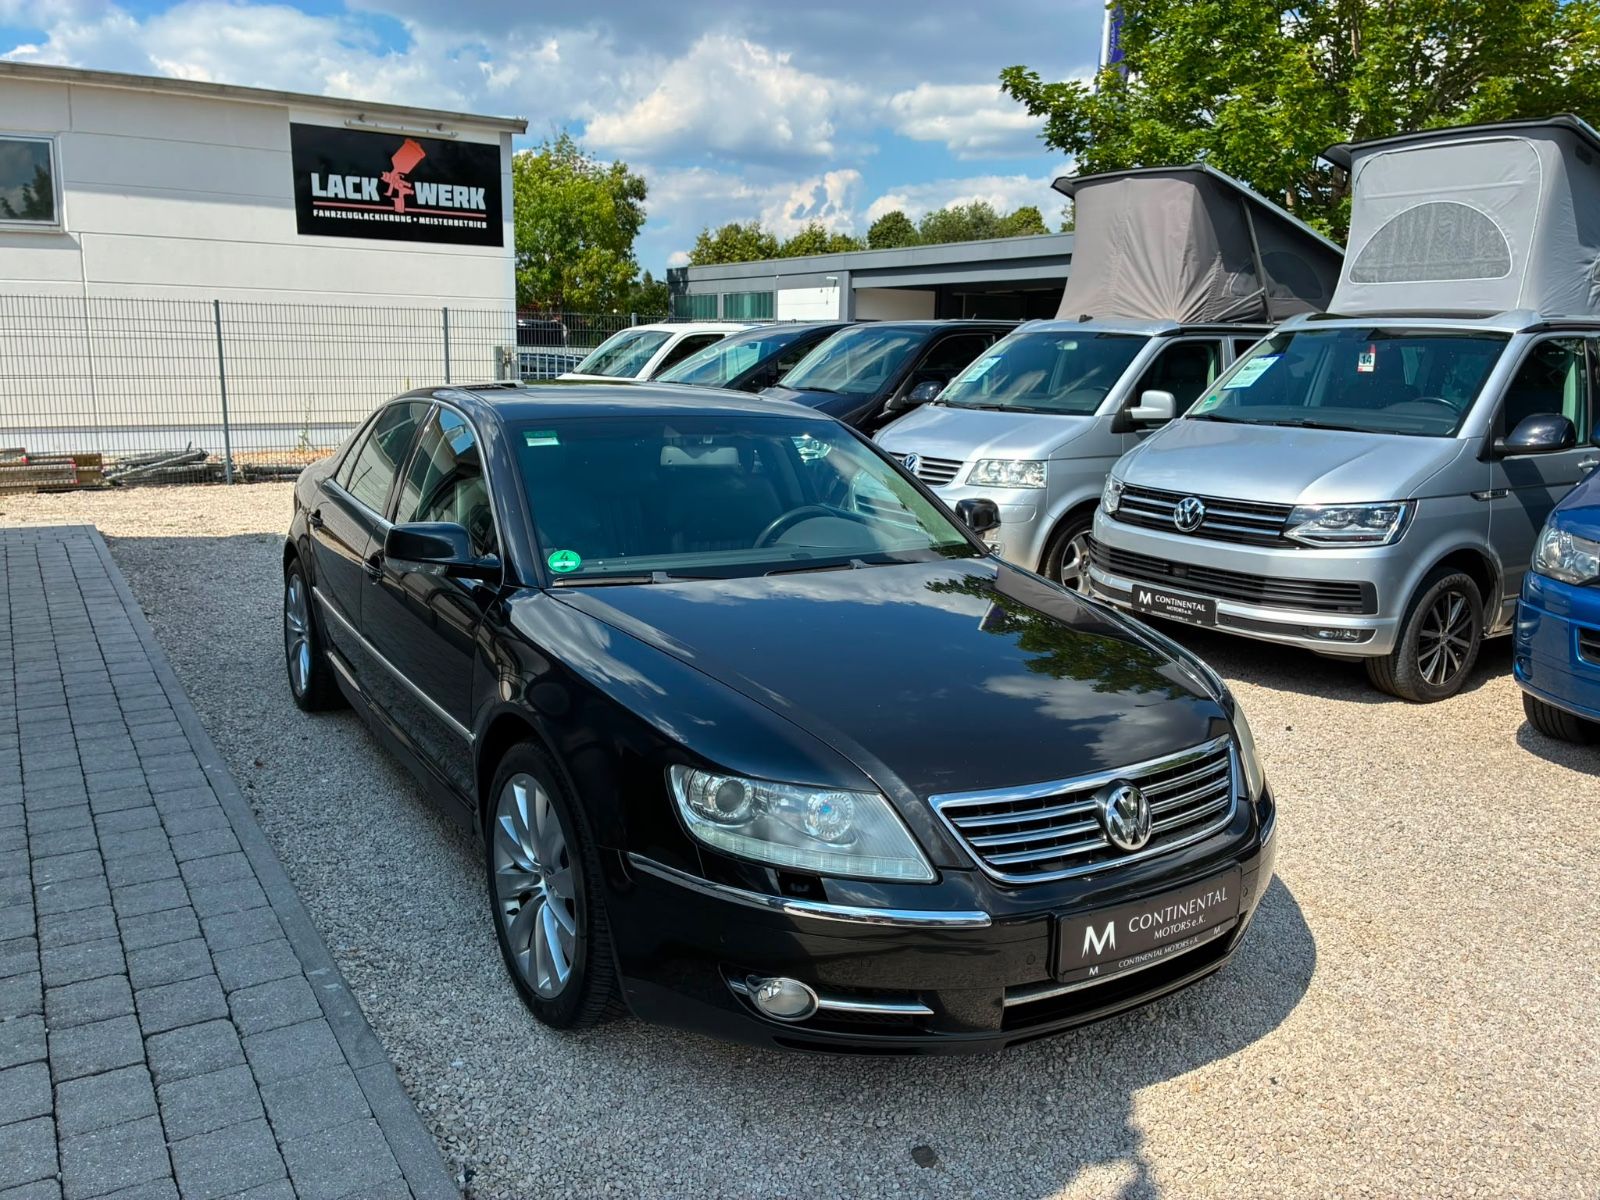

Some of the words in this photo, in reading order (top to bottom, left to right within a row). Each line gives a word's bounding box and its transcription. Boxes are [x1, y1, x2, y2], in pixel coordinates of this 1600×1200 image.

[311, 173, 380, 201] LACK
[414, 181, 486, 210] WERK
[313, 209, 411, 222] FAHRZEUGLACKIERUNG
[419, 217, 487, 229] MEISTERBETRIEB
[1155, 595, 1206, 612] CONTINENTAL
[1128, 887, 1228, 933] CONTINENTAL
[1082, 921, 1116, 959] M
[1154, 919, 1192, 940] MOTORS
[1192, 914, 1207, 928] e.K.
[1118, 950, 1164, 968] CONTINENTAL
[1164, 939, 1189, 955] MOTORS
